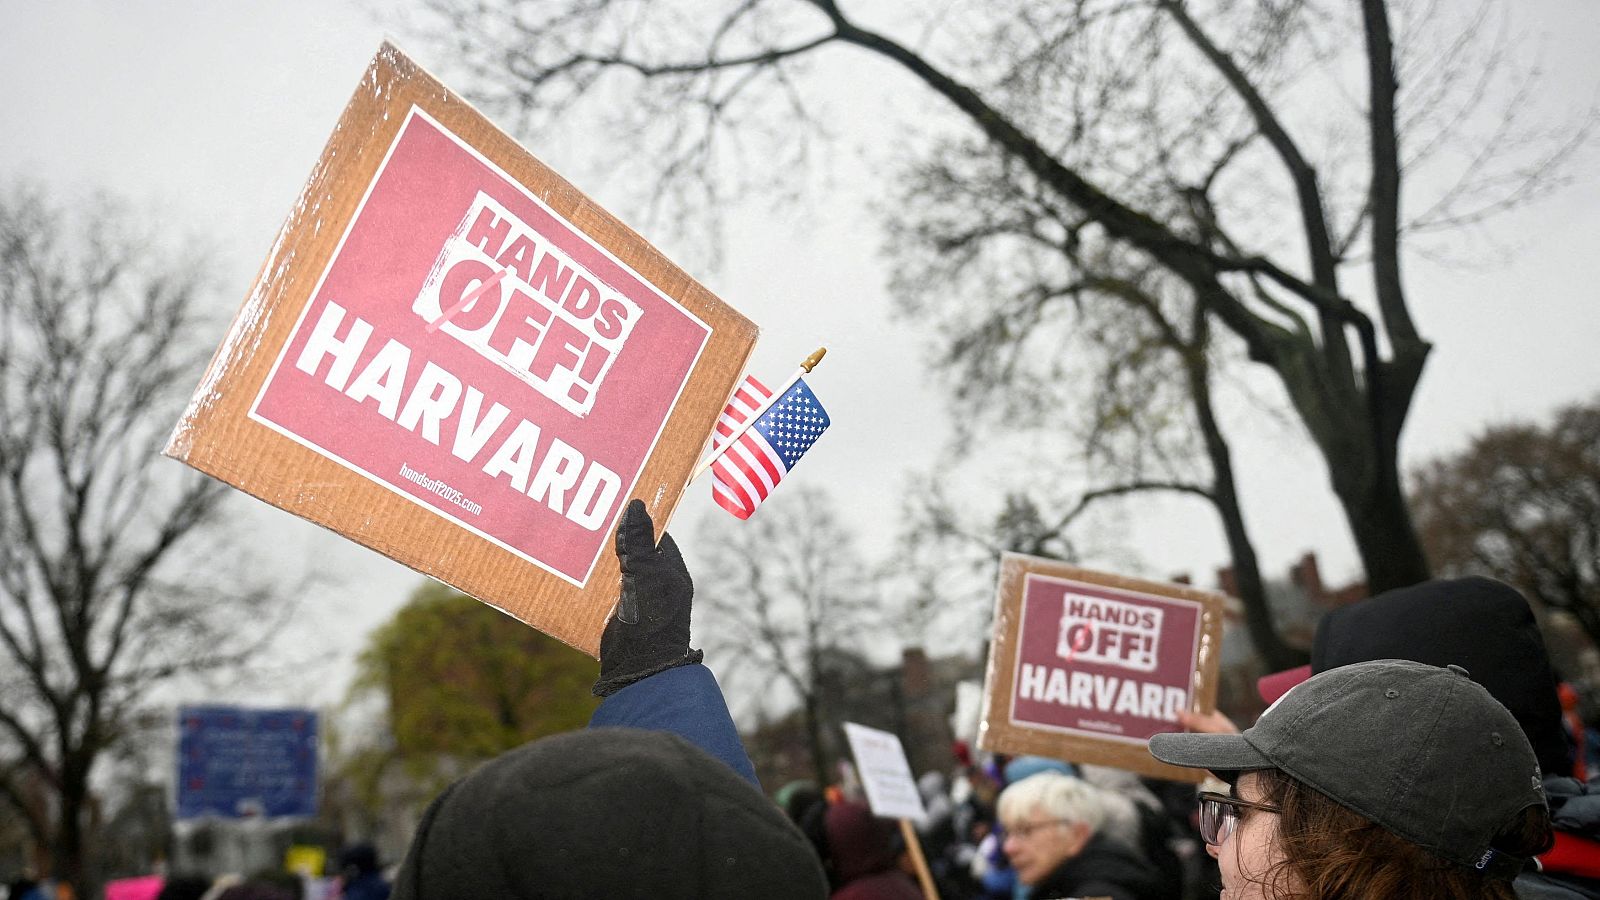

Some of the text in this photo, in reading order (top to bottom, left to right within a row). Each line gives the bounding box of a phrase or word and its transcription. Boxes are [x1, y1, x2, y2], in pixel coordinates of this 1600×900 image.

[465, 205, 628, 340] HANDS
[438, 259, 611, 405] OFF!
[295, 300, 622, 532] HARVARD
[398, 462, 483, 516] handsoff2025.com
[1068, 599, 1156, 629] HANDS
[1066, 624, 1154, 664] OFF!
[1019, 663, 1187, 721] HARVARD
